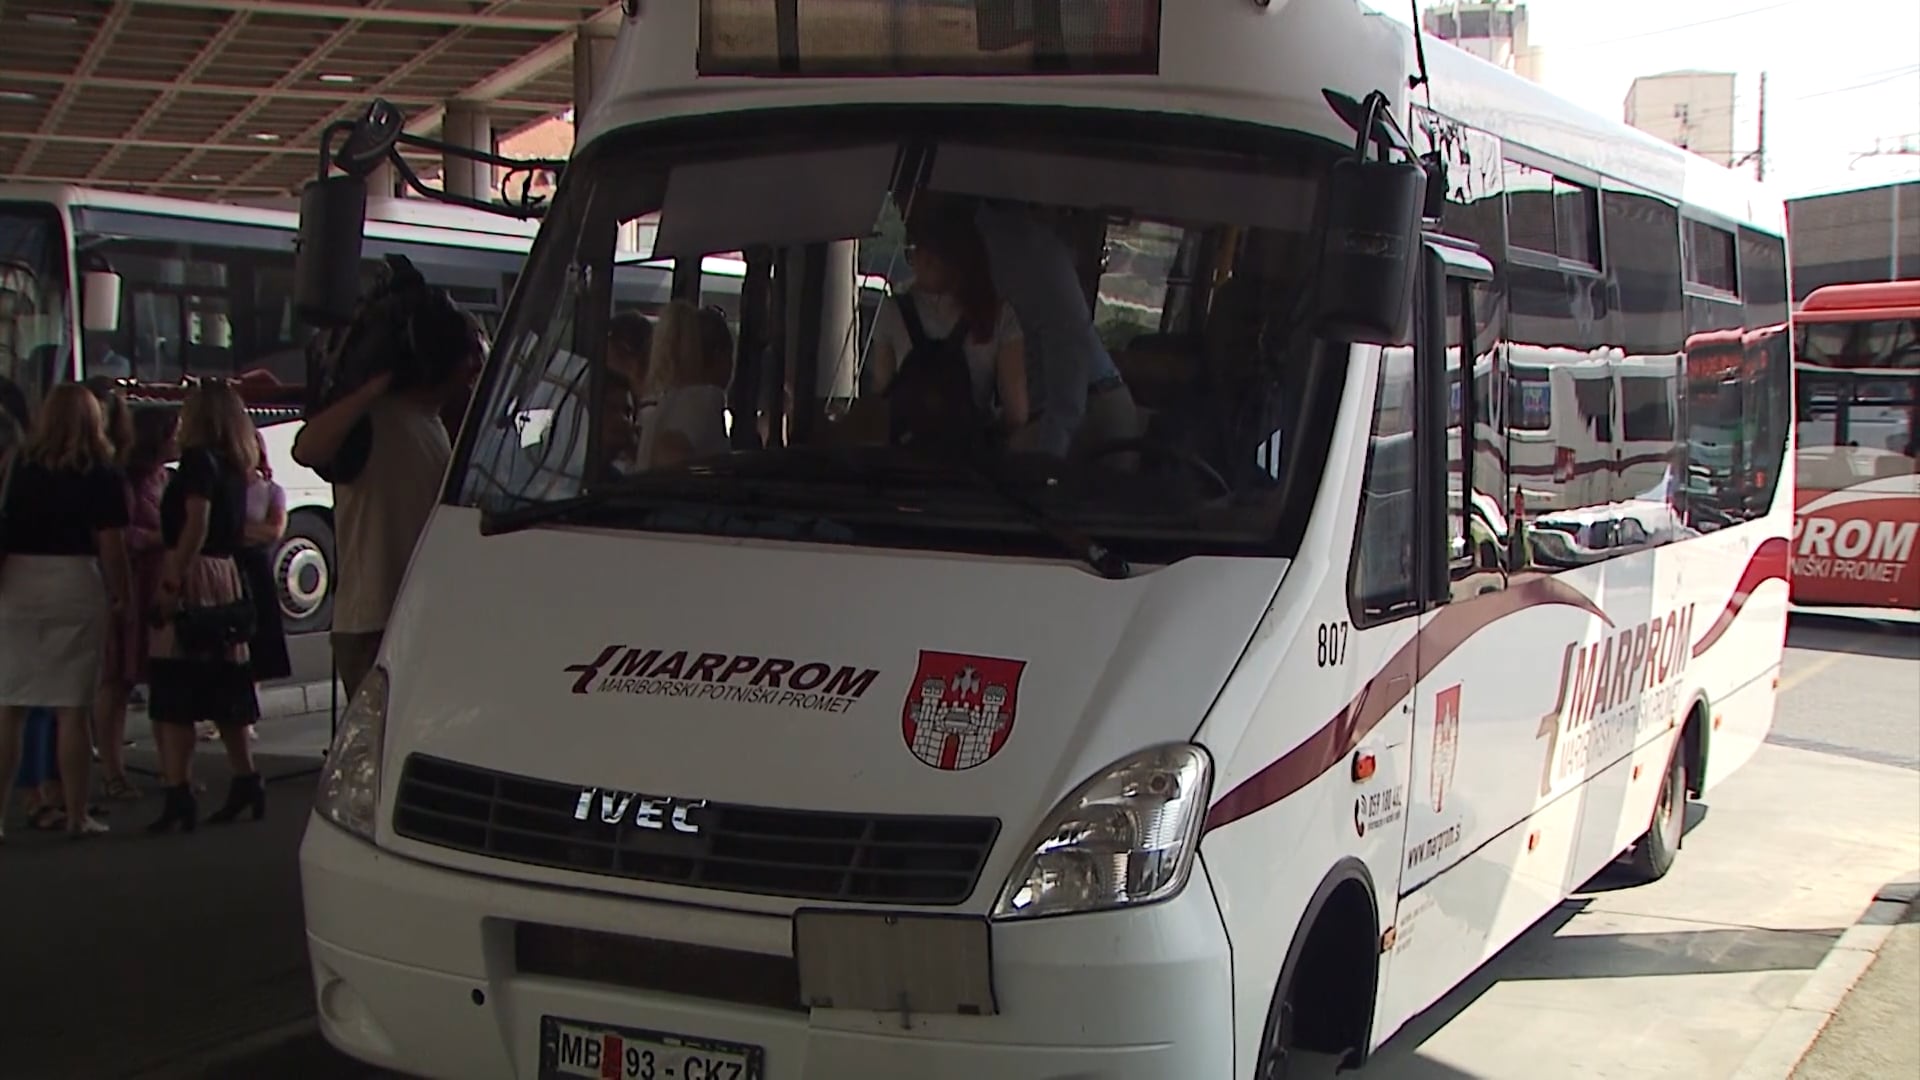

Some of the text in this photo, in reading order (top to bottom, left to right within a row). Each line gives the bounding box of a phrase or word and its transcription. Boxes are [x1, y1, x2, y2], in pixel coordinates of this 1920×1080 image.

[1831, 559, 1907, 583] PROMET
[1318, 621, 1348, 668] 807
[1567, 603, 1695, 732] MARPROM
[597, 678, 857, 714] MARIBORSKI POTNIŠKI PROMET
[609, 648, 880, 698] MARPROM
[574, 787, 706, 833] IVEC
[561, 1033, 600, 1068] MB
